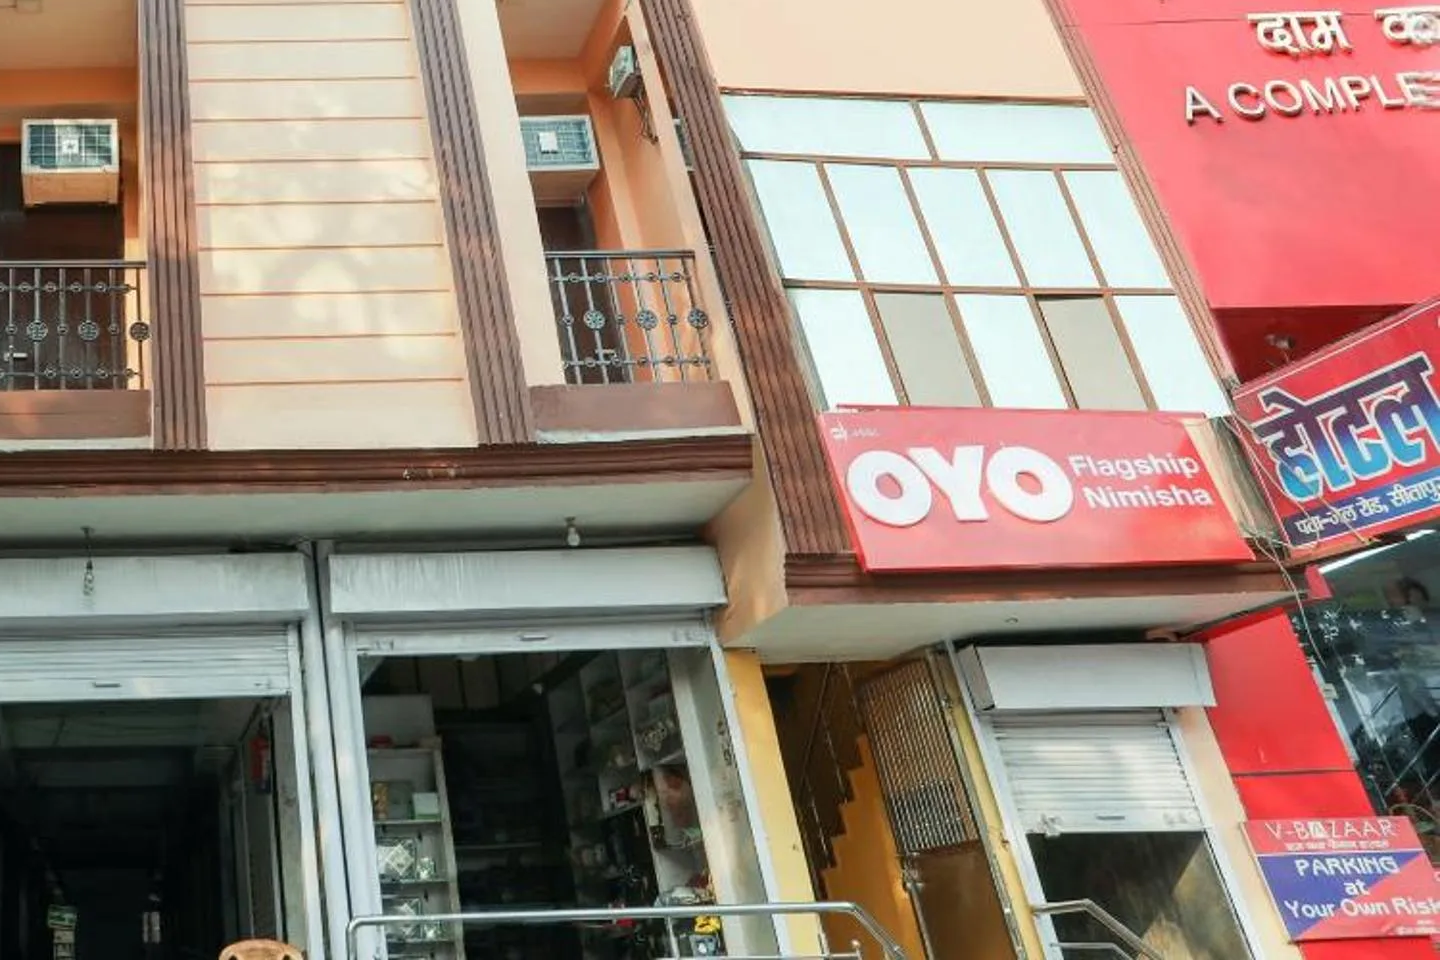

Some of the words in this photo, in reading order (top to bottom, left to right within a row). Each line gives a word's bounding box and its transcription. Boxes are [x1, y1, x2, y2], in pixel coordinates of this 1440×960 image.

[1248, 10, 1353, 53] दाम
[1185, 86, 1224, 124] A
[1251, 351, 1440, 502] होटल
[846, 444, 1073, 527] OYO
[1068, 453, 1200, 479] Flagship
[1083, 485, 1213, 509] Nimisha
[1264, 819, 1397, 840] V-BAZAAR
[1294, 856, 1401, 876] PARKING
[1343, 879, 1371, 896] at
[1284, 900, 1336, 919] Your
[1340, 898, 1391, 917] Own
